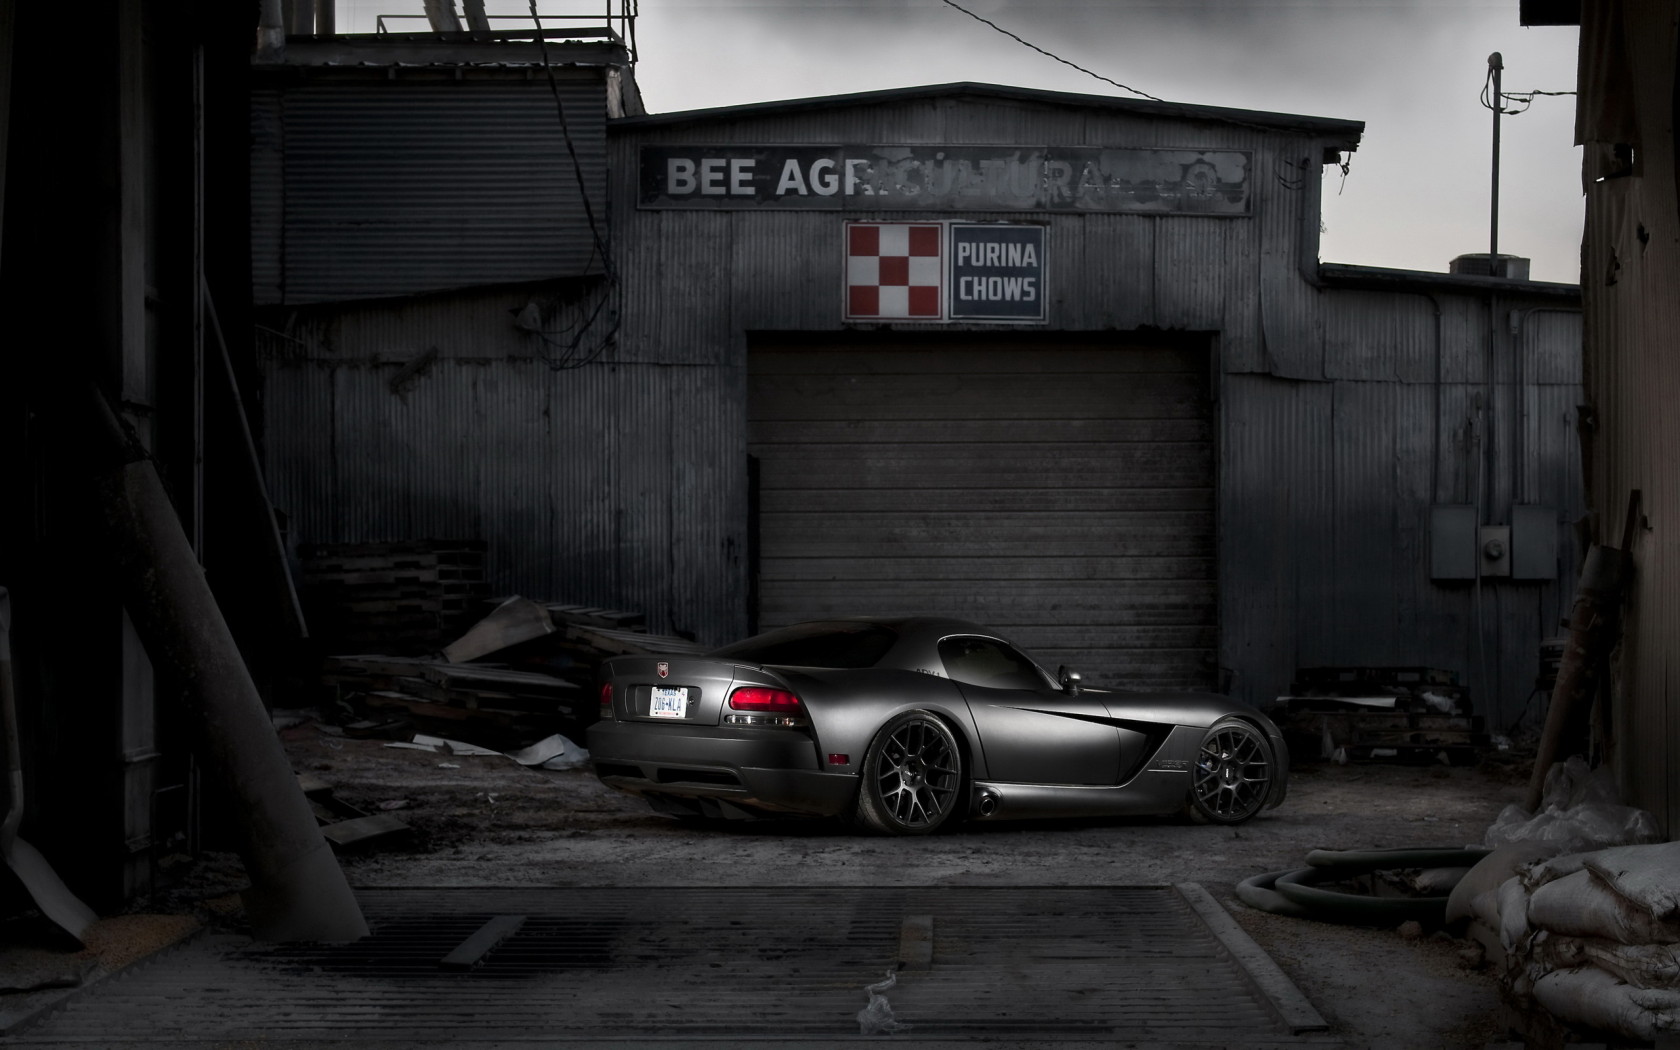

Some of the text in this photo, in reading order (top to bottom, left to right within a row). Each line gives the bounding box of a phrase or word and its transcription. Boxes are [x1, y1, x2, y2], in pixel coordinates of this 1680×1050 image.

[667, 158, 756, 195] BEE
[775, 158, 1135, 198] AGRICULTURA
[957, 242, 1038, 268] PURINA
[959, 276, 1036, 302] CHOWS
